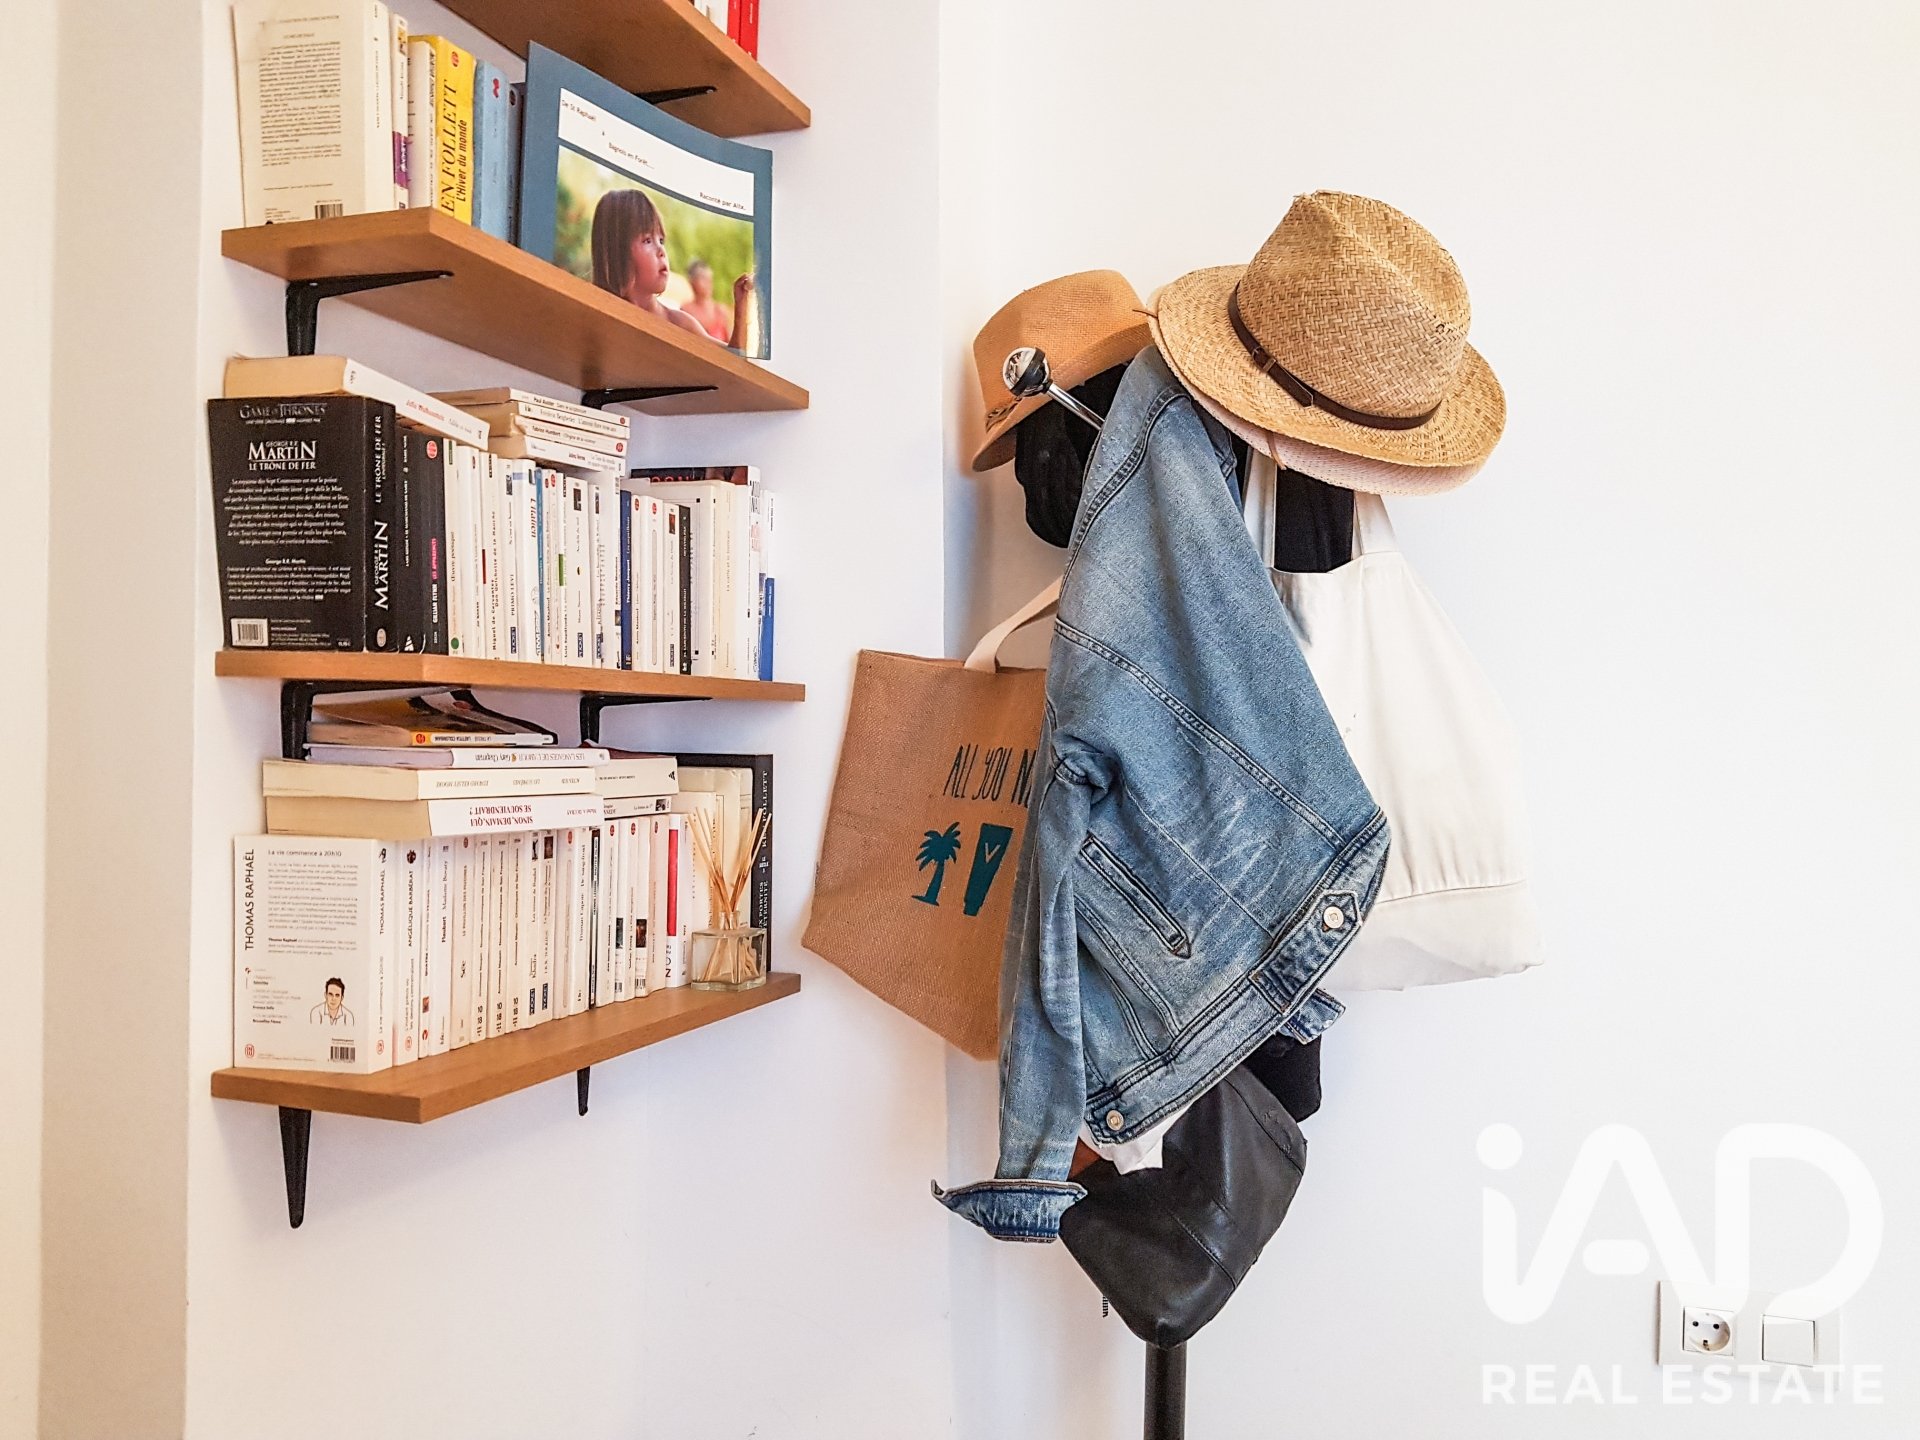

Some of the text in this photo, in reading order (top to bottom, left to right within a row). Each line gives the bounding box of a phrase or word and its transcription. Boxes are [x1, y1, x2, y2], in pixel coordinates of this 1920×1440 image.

[442, 79, 458, 178] FOLLETT
[456, 119, 468, 202] L'Hiver du monde
[722, 200, 732, 208] par
[239, 405, 270, 418] GAME
[278, 403, 327, 417] THRONES
[248, 440, 317, 460] MARTIN
[375, 437, 382, 451] DE
[288, 462, 300, 470] DE
[302, 462, 317, 470] FER
[374, 492, 381, 504] LE
[374, 520, 388, 610] MARTIN
[943, 743, 978, 799] ALL
[972, 747, 1012, 802] YOU
[470, 818, 483, 827] QUI
[243, 849, 254, 951] THOMAS RAPHAËL
[406, 907, 414, 946] ANGÉLIQUE
